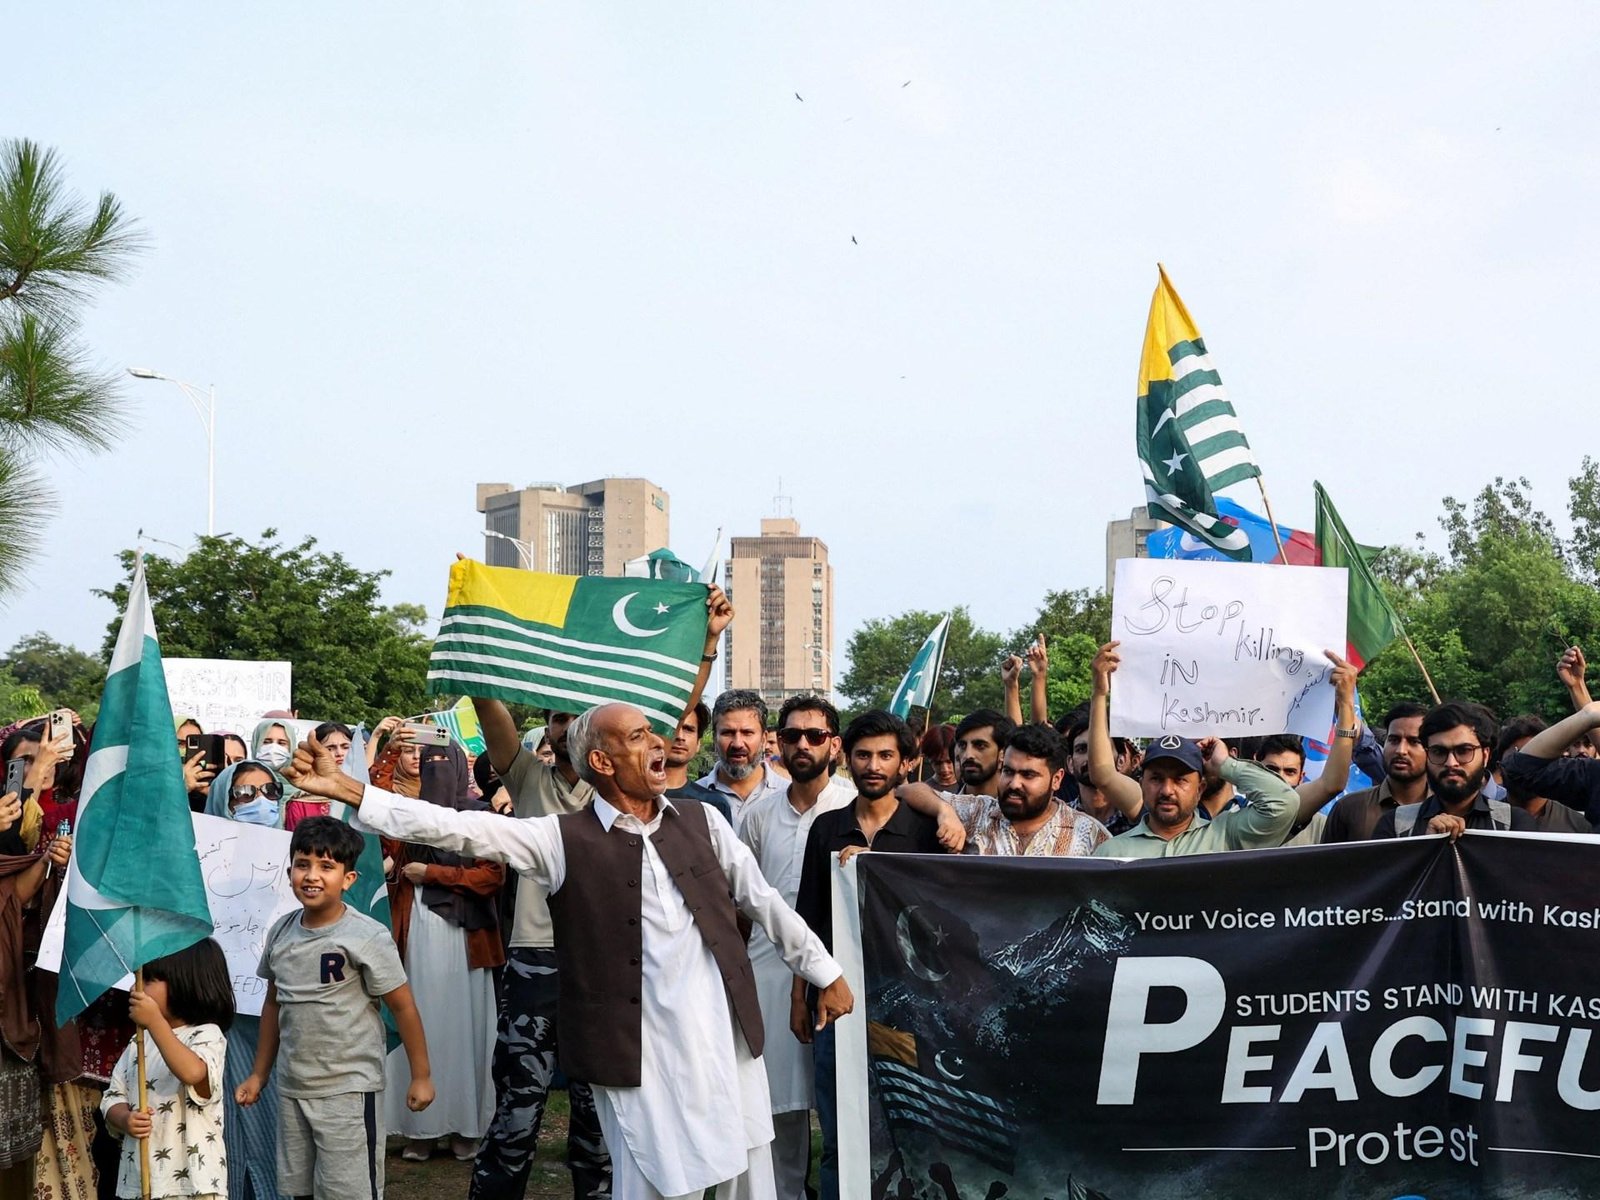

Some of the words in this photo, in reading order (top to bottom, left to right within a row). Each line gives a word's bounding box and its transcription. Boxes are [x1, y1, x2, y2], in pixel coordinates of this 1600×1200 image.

[1123, 575, 1244, 636] Stop
[1135, 911, 1194, 931] Your
[1201, 907, 1276, 929] Voice
[1478, 900, 1534, 923] with
[320, 953, 346, 984] R
[1236, 990, 1371, 1017] STUDENTS
[1384, 983, 1463, 1010] STAND
[1471, 986, 1538, 1014] WITH
[1308, 1122, 1479, 1168] Protest
